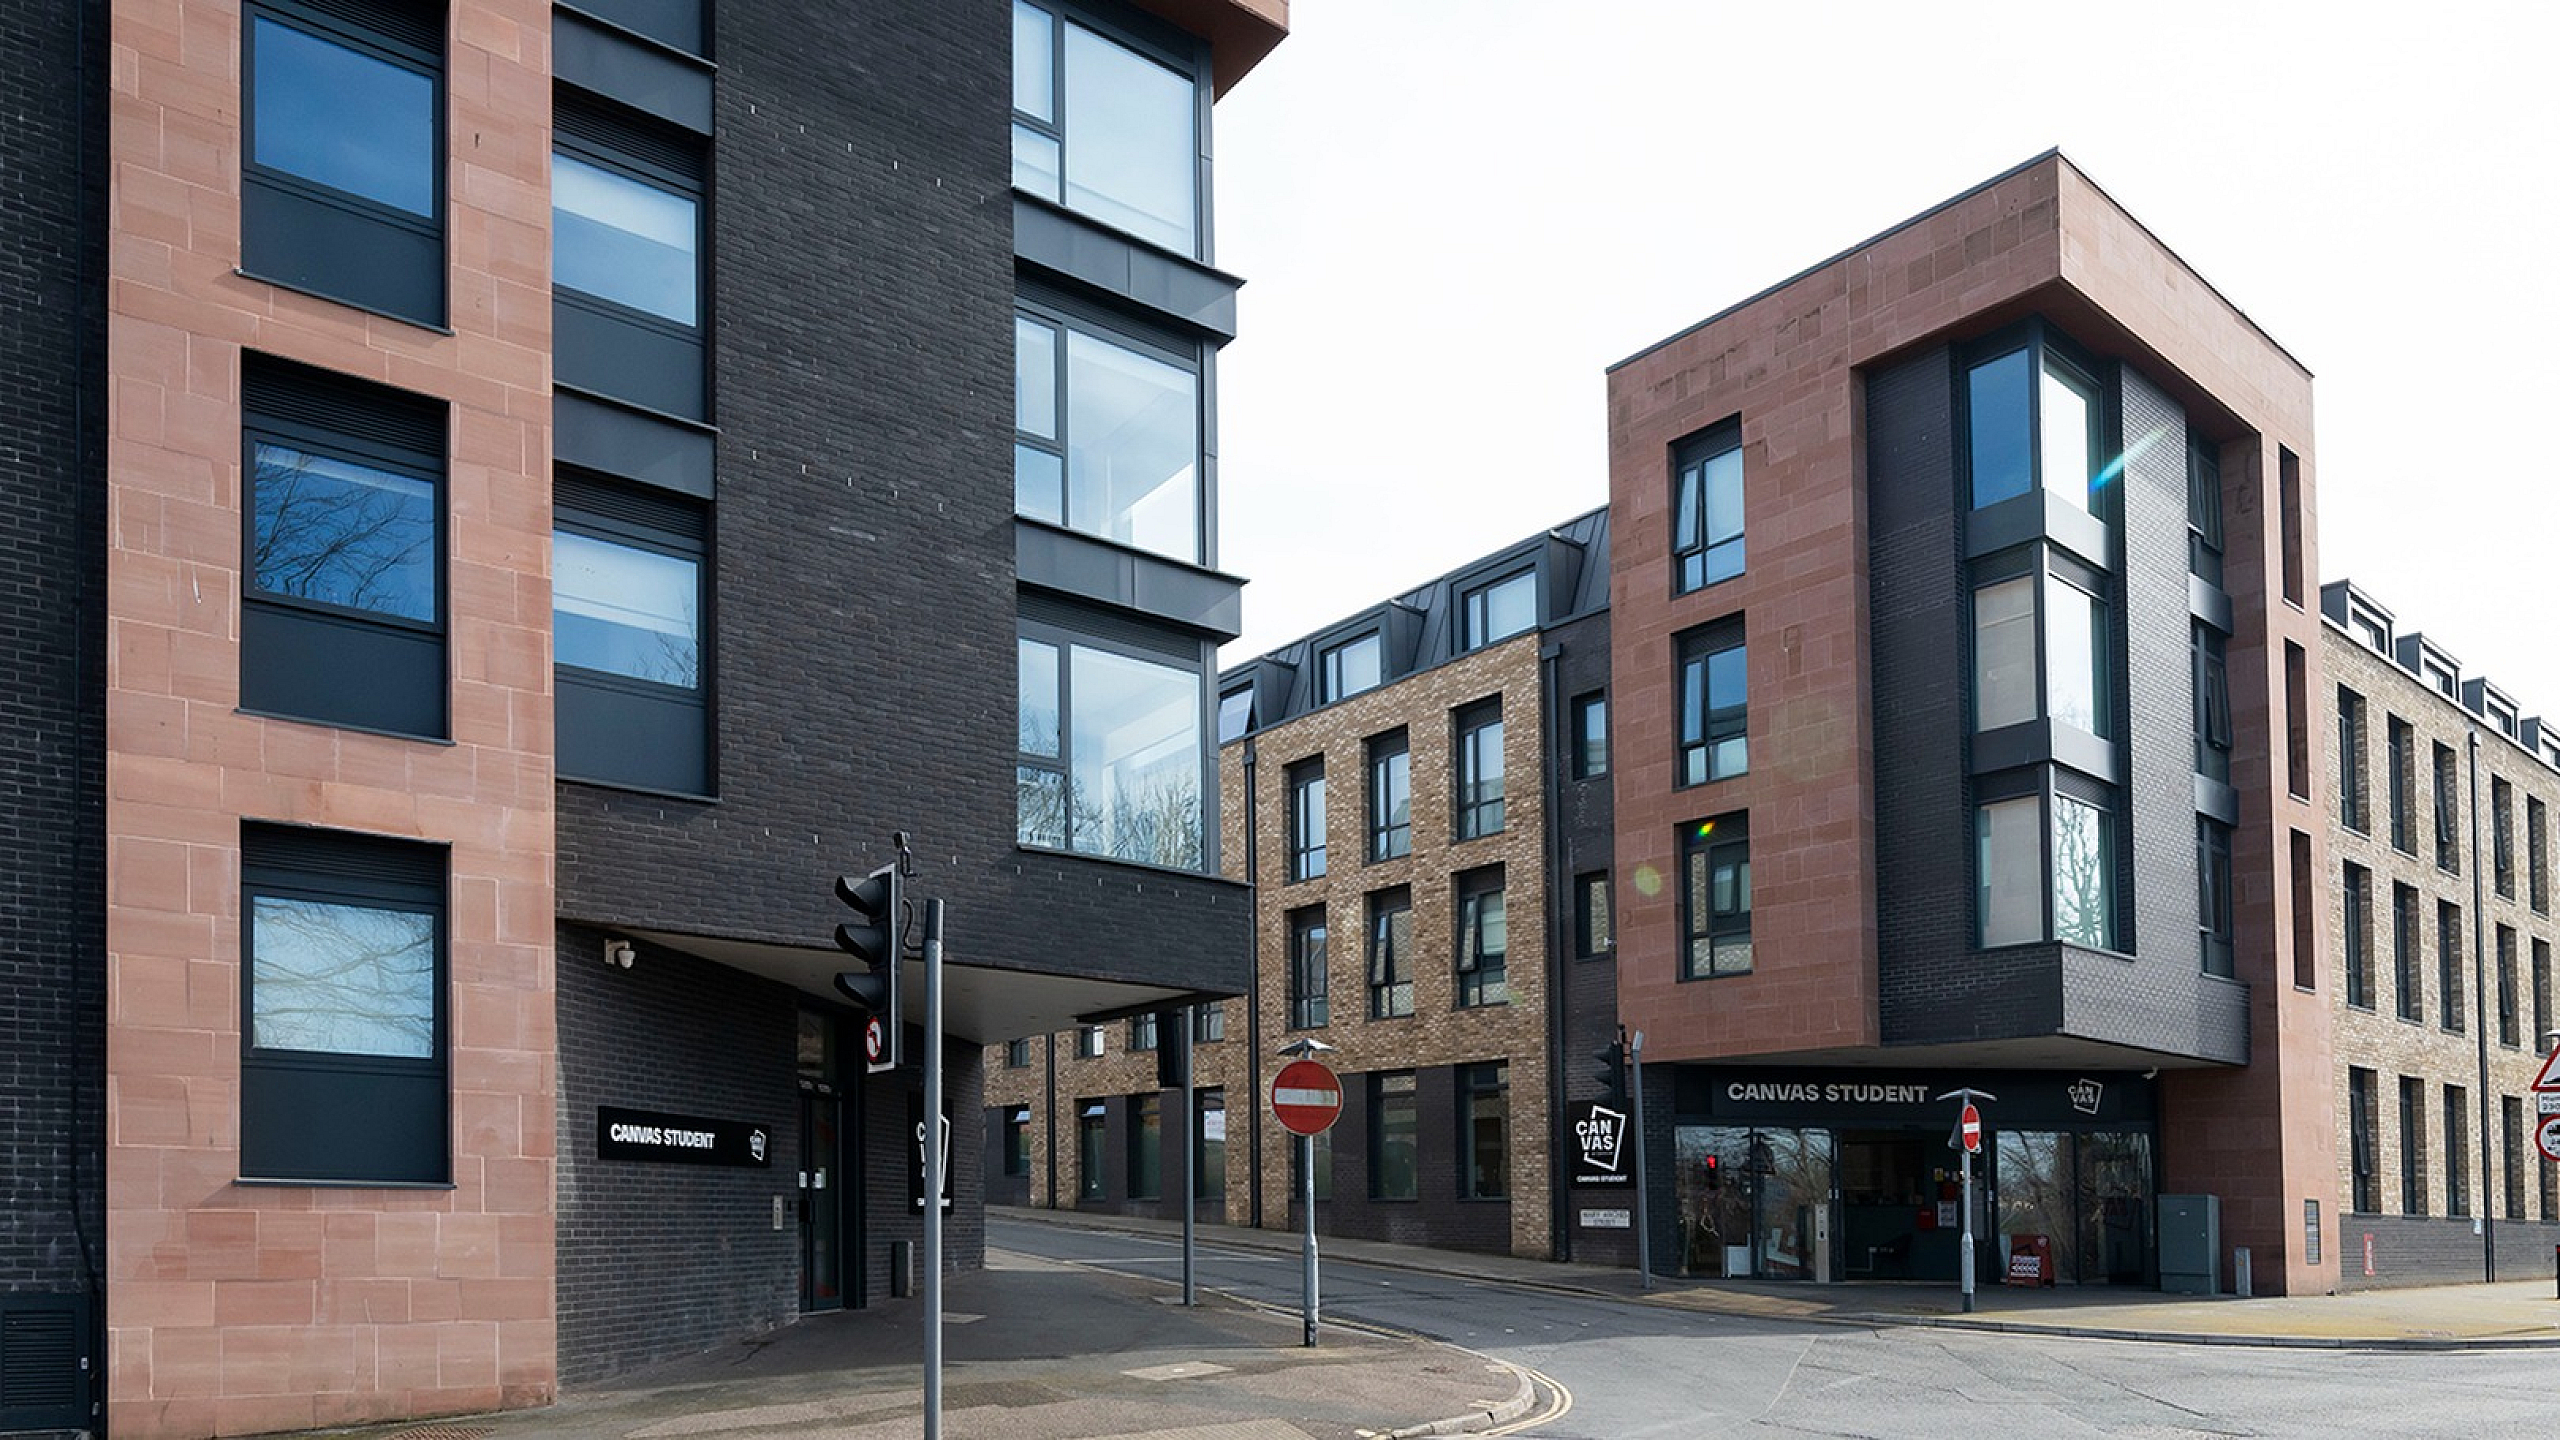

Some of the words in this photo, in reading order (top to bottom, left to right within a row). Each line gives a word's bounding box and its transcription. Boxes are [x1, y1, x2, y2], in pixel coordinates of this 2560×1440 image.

[1727, 1083, 1819, 1101] CANVAS
[1825, 1083, 1929, 1103] STUDENT
[610, 1123, 662, 1145] CANVAS
[663, 1128, 715, 1149] STUDENT
[1576, 1120, 1612, 1135] CAN
[1581, 1136, 1614, 1150] VAS
